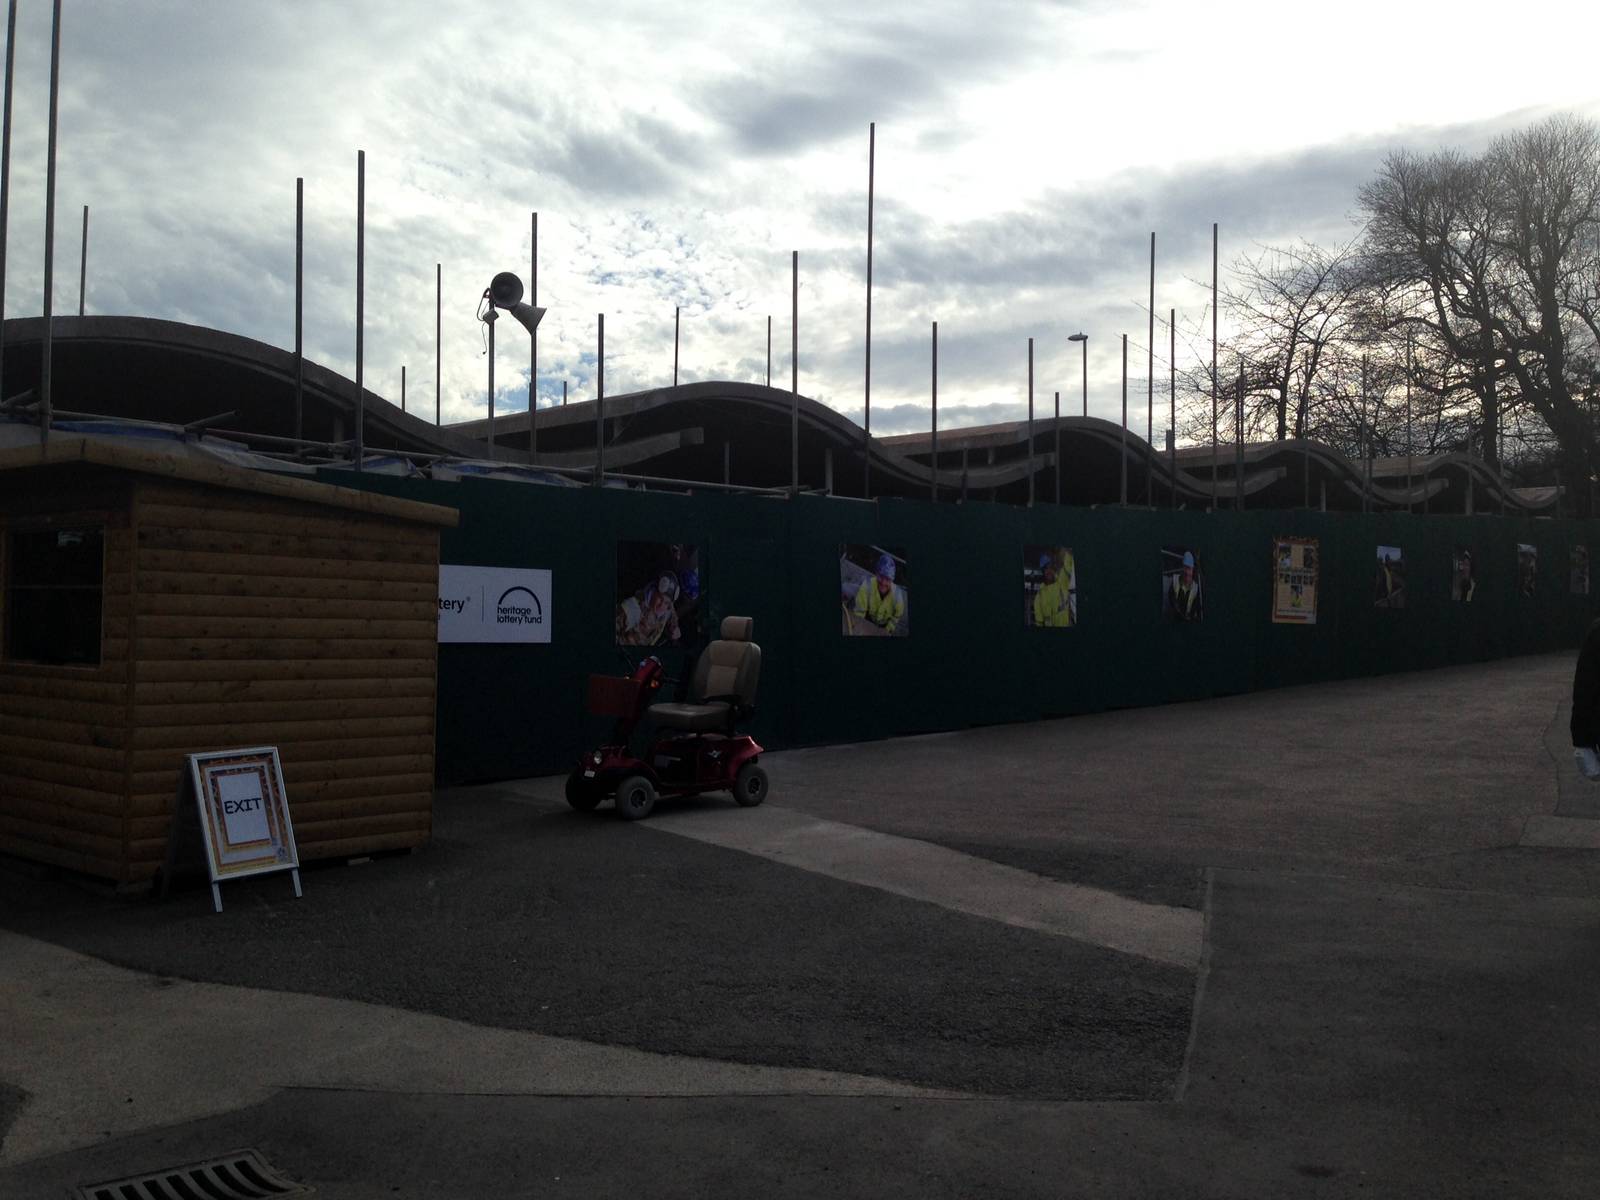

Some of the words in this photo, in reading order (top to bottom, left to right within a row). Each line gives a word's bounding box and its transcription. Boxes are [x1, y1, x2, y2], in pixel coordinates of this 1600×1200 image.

[497, 606, 531, 616] heritage
[497, 615, 523, 625] lottery
[524, 615, 542, 624] fund
[224, 797, 262, 814] EXIT
